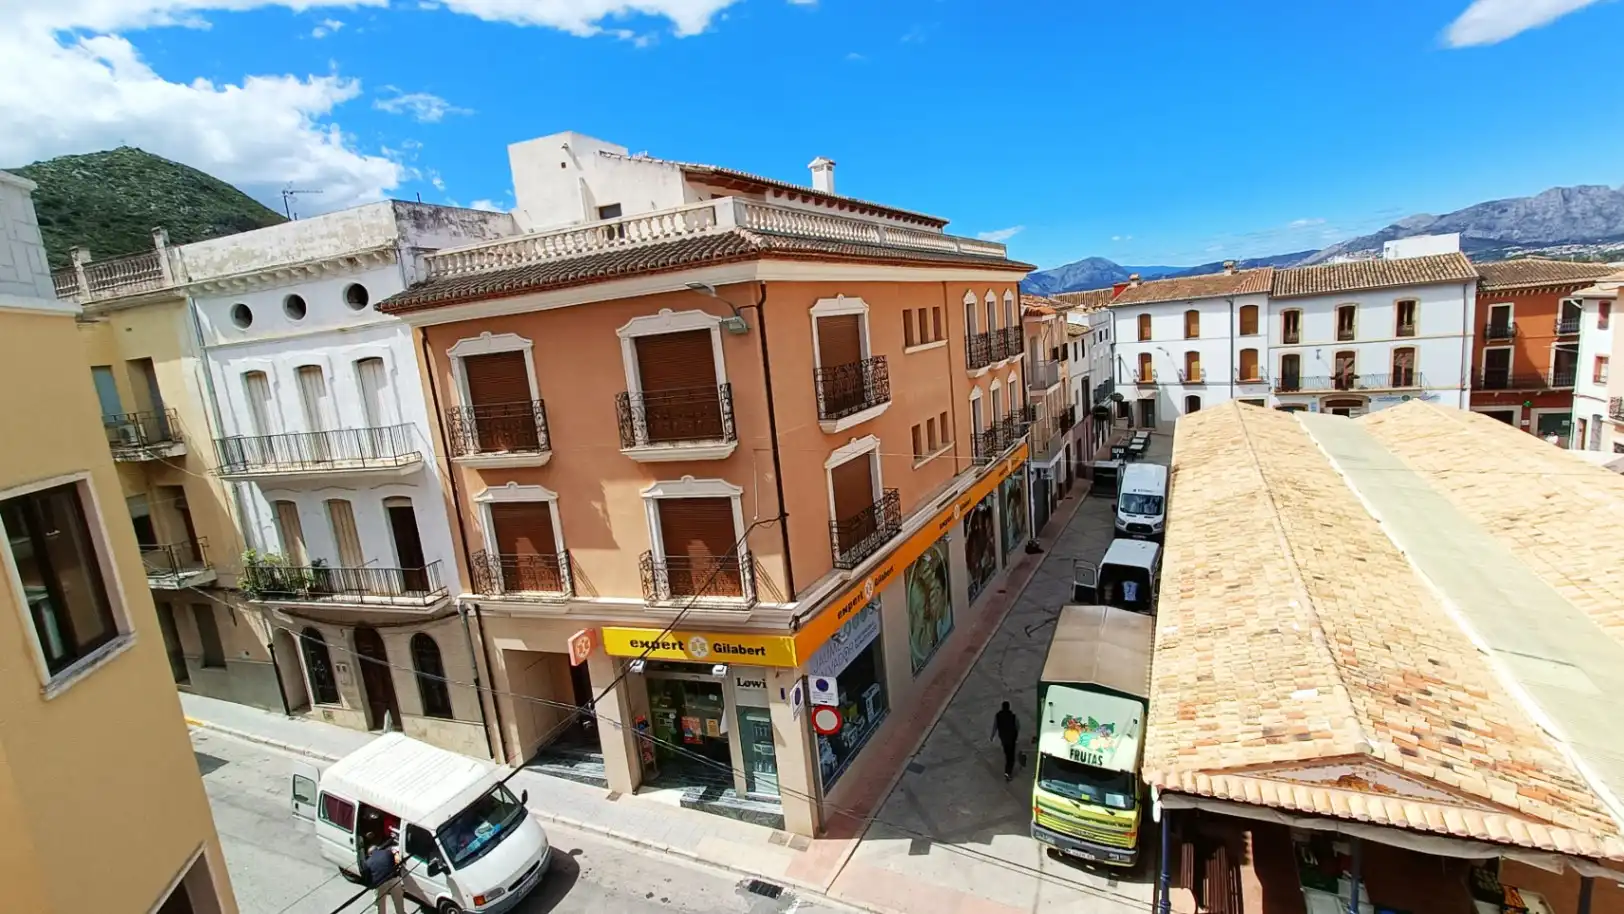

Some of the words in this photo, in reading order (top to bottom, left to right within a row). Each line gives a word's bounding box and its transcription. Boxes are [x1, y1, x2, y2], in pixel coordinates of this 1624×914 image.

[837, 590, 864, 619] expert
[629, 638, 685, 652] expert
[712, 642, 767, 656] Gilabert
[736, 677, 767, 689] Lowi
[1069, 748, 1103, 766] FRUTAS
